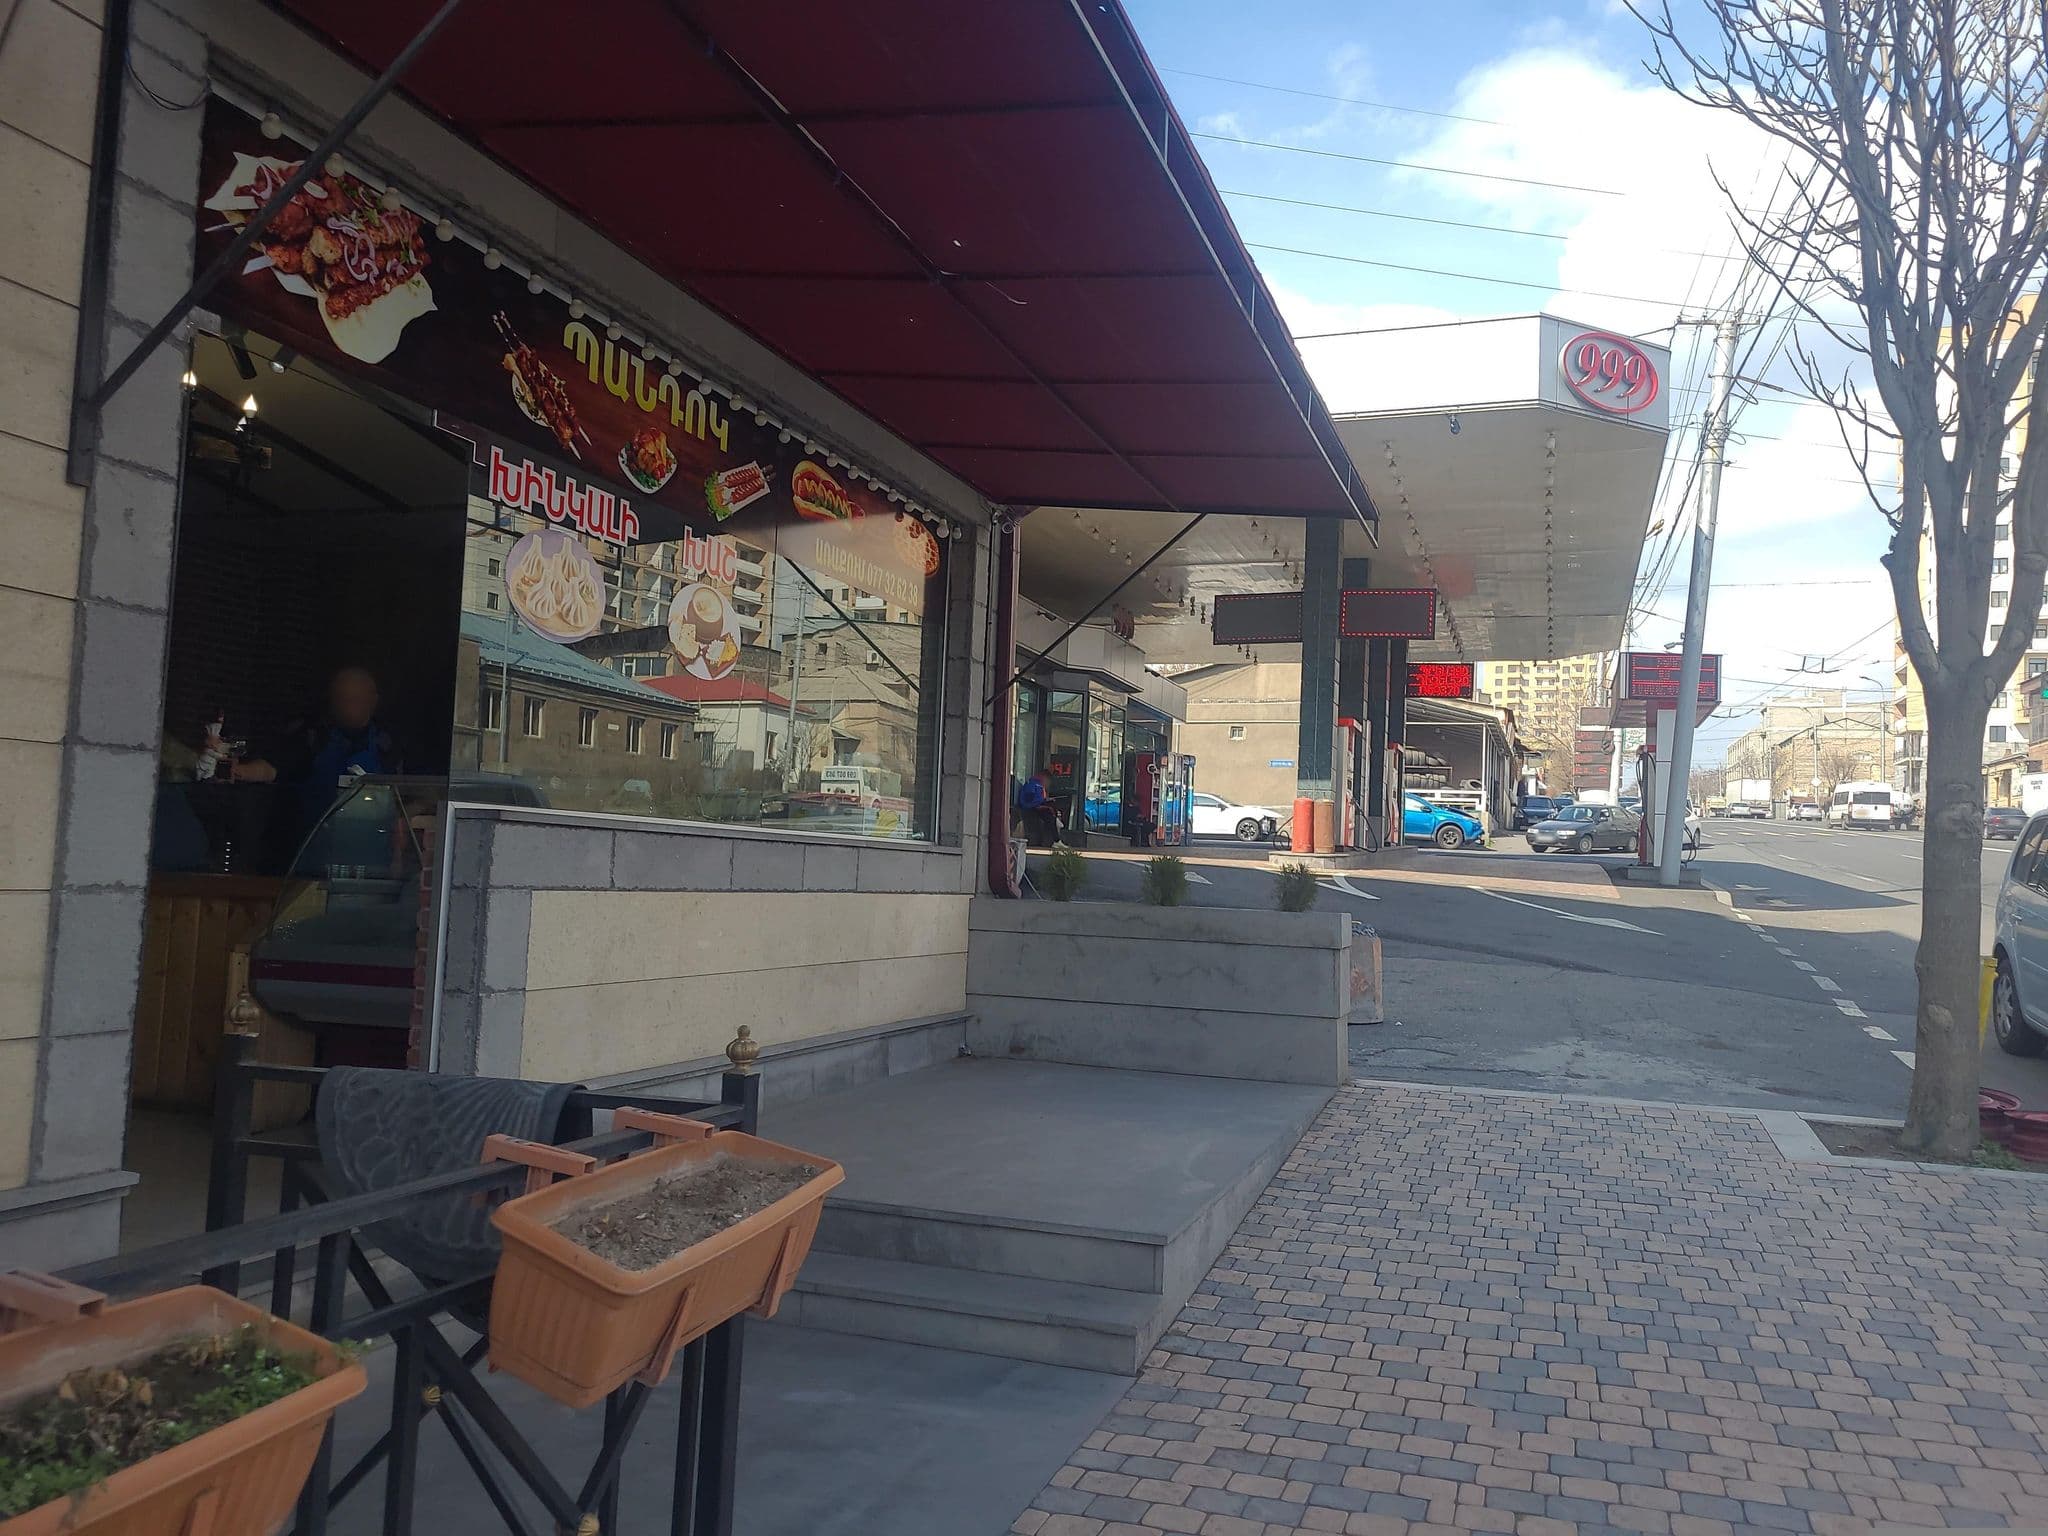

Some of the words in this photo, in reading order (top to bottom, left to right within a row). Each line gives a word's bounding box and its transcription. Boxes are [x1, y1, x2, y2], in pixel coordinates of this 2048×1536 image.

[563, 321, 730, 453] ՊԱՆԴՈԿ
[1574, 342, 1648, 399] 999
[490, 447, 639, 545] ԽԻՆԿԱԼԻ
[683, 527, 737, 584] ԽԱՇ
[866, 562, 882, 589] 077
[884, 572, 895, 596] 32
[896, 579, 907, 601] 62
[908, 583, 918, 607] 38
